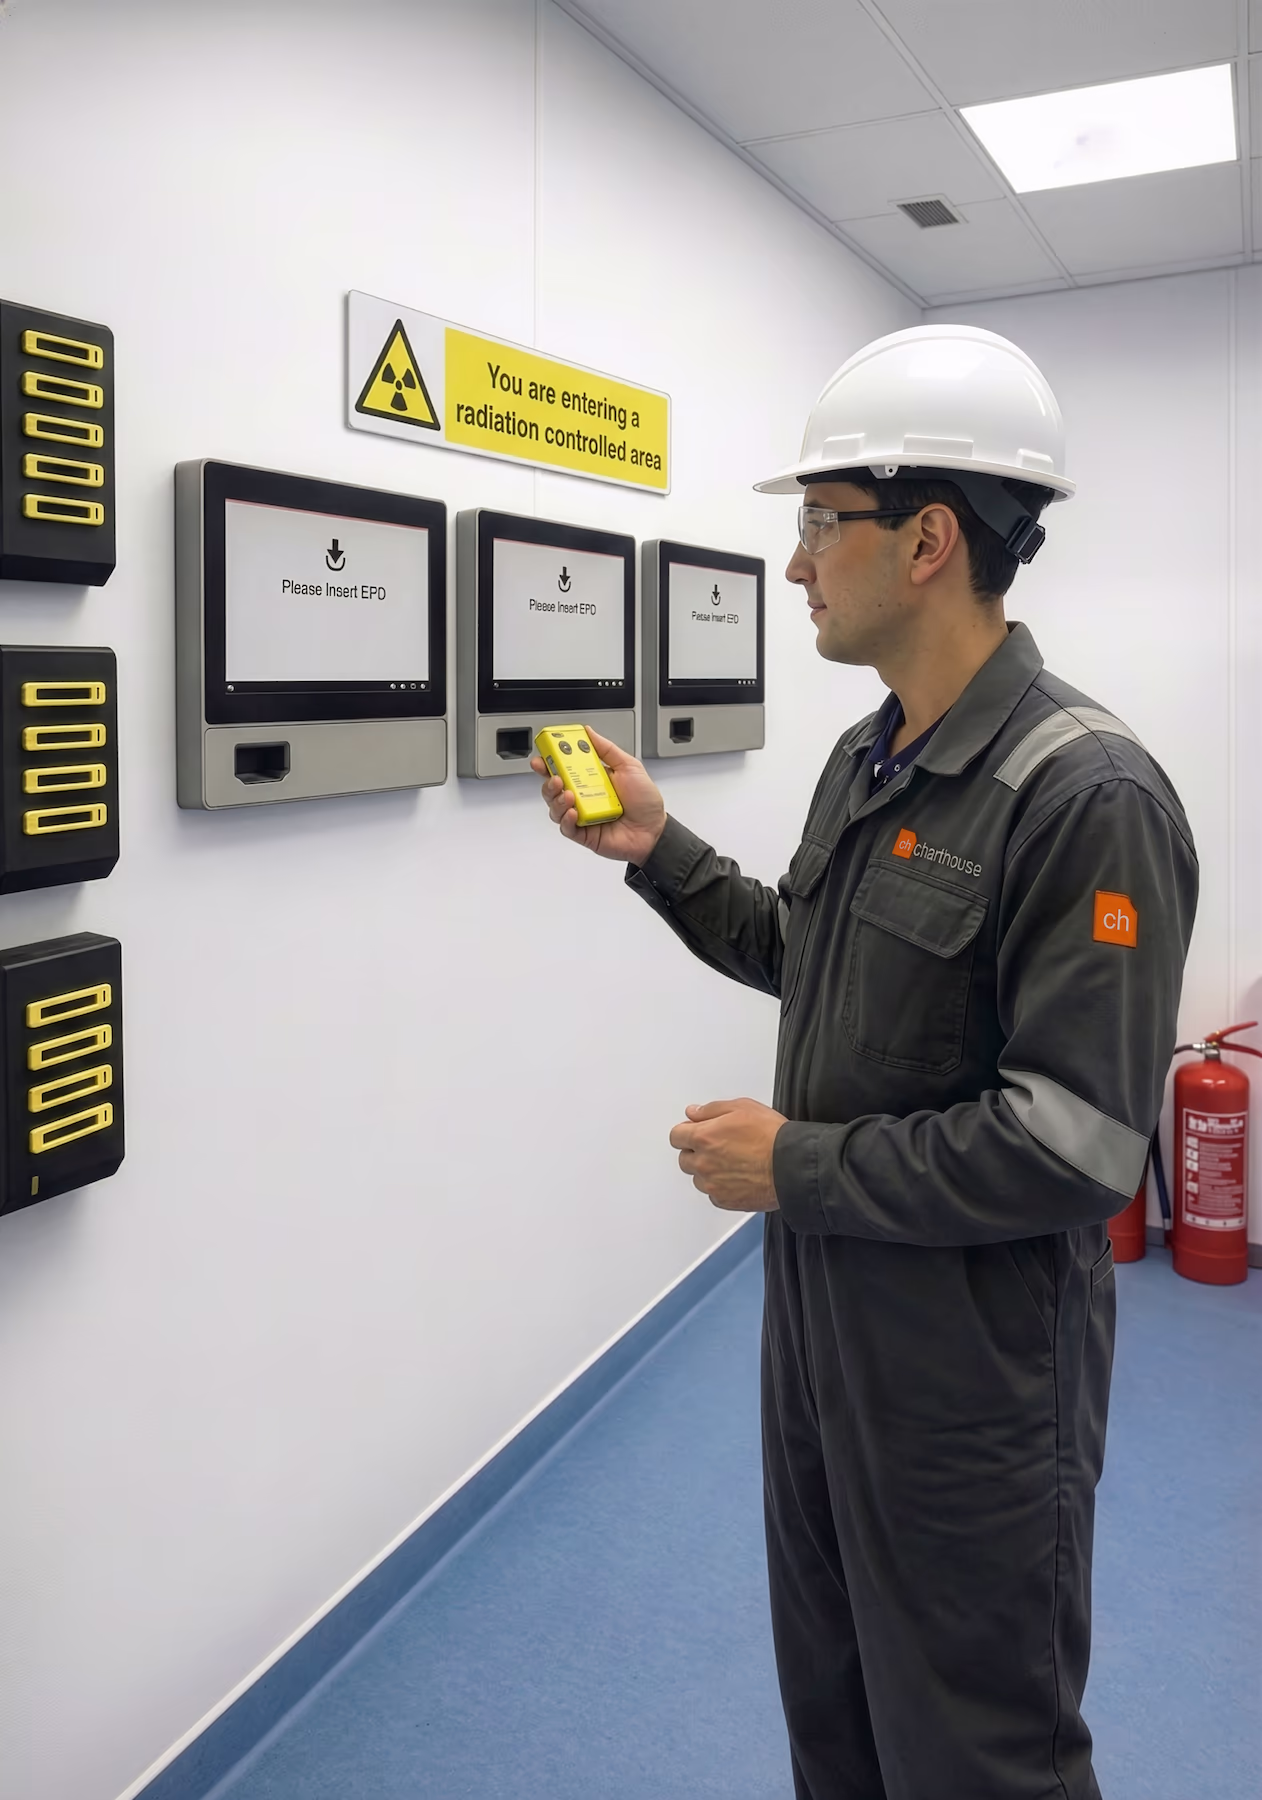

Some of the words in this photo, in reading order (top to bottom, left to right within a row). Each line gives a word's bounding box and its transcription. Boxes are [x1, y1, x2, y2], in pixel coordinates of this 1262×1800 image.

[487, 361, 522, 396] You
[528, 381, 556, 405] are
[561, 390, 627, 430] entering
[631, 411, 640, 428] a
[456, 402, 539, 441] radiation
[545, 426, 626, 462] controlled
[630, 448, 662, 471] area
[282, 579, 322, 596] Please
[326, 582, 357, 598] Insert
[361, 585, 386, 600] EPD
[529, 598, 555, 612] Please
[579, 603, 596, 615] EPD
[898, 839, 912, 851] ch
[913, 842, 982, 877] charthouse
[1103, 908, 1130, 932] ch
